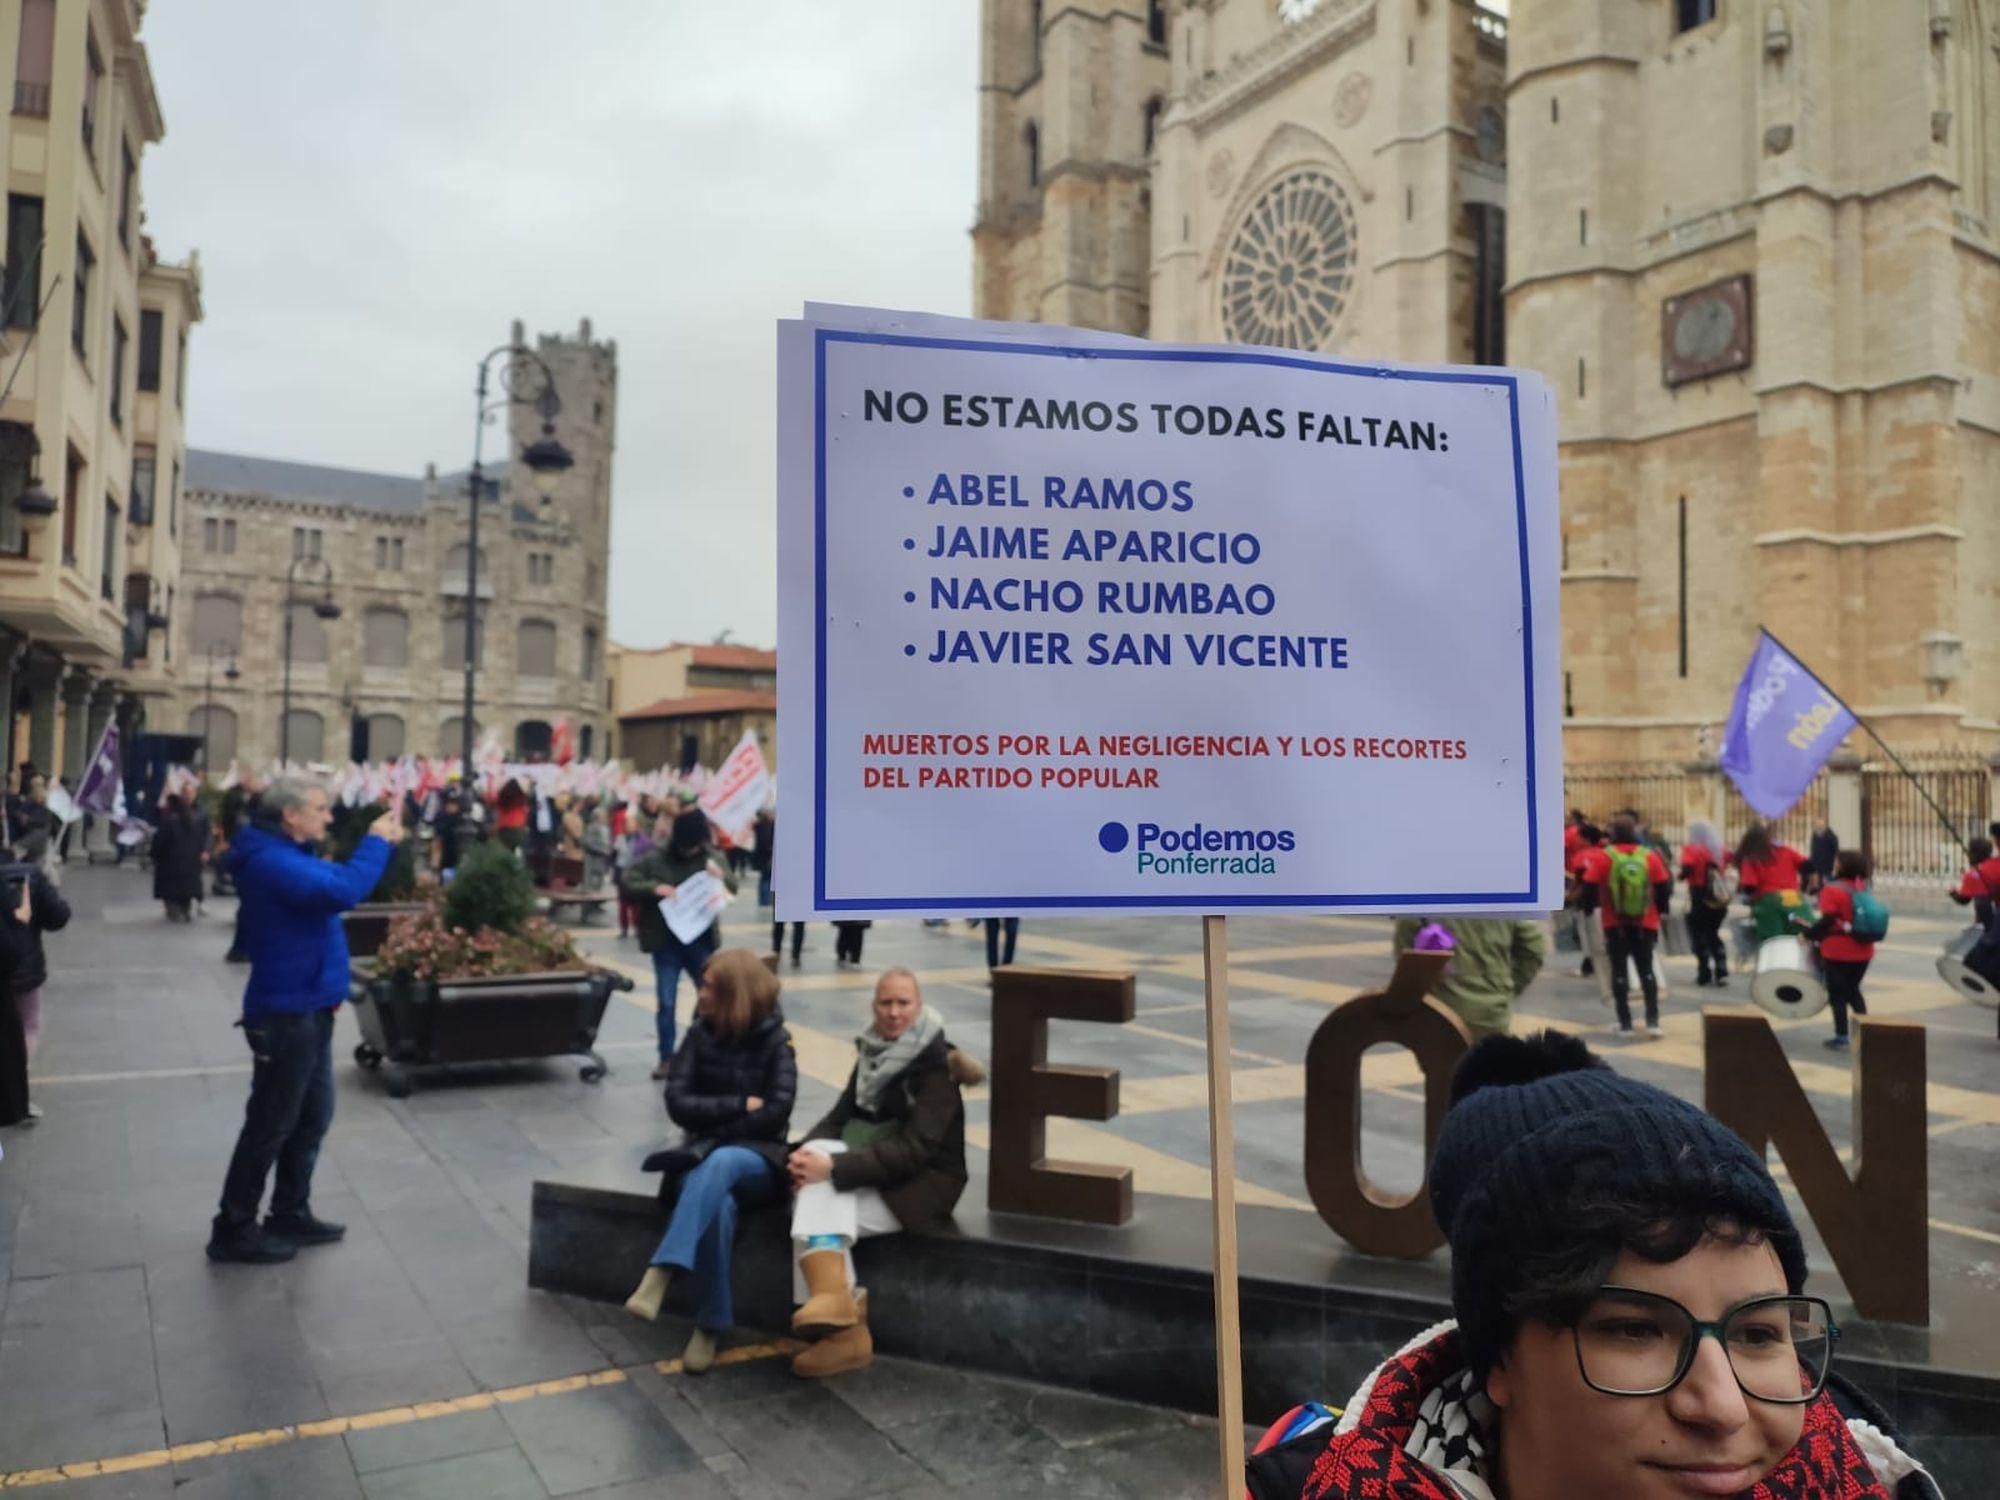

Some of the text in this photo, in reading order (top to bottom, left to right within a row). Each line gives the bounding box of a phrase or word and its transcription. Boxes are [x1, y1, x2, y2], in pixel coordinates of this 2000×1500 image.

[863, 389, 1450, 453] NO ESTAMOS TODAS FALTAN:
[927, 473, 1194, 513] ABEL RAMOS
[927, 525, 1261, 565] JAIME APARICIO
[930, 576, 1276, 616] NACHO RUMBAO
[927, 629, 1349, 670] JAVIER SAN VICENTE
[863, 734, 1467, 760] MUERTOS POR LA NEGLIGENCIA Y LOS RECORTES
[864, 767, 1160, 789] DEL PARTIDO POPULAR
[1137, 822, 1296, 853] Podemos
[1137, 851, 1276, 875] Ponferrada
